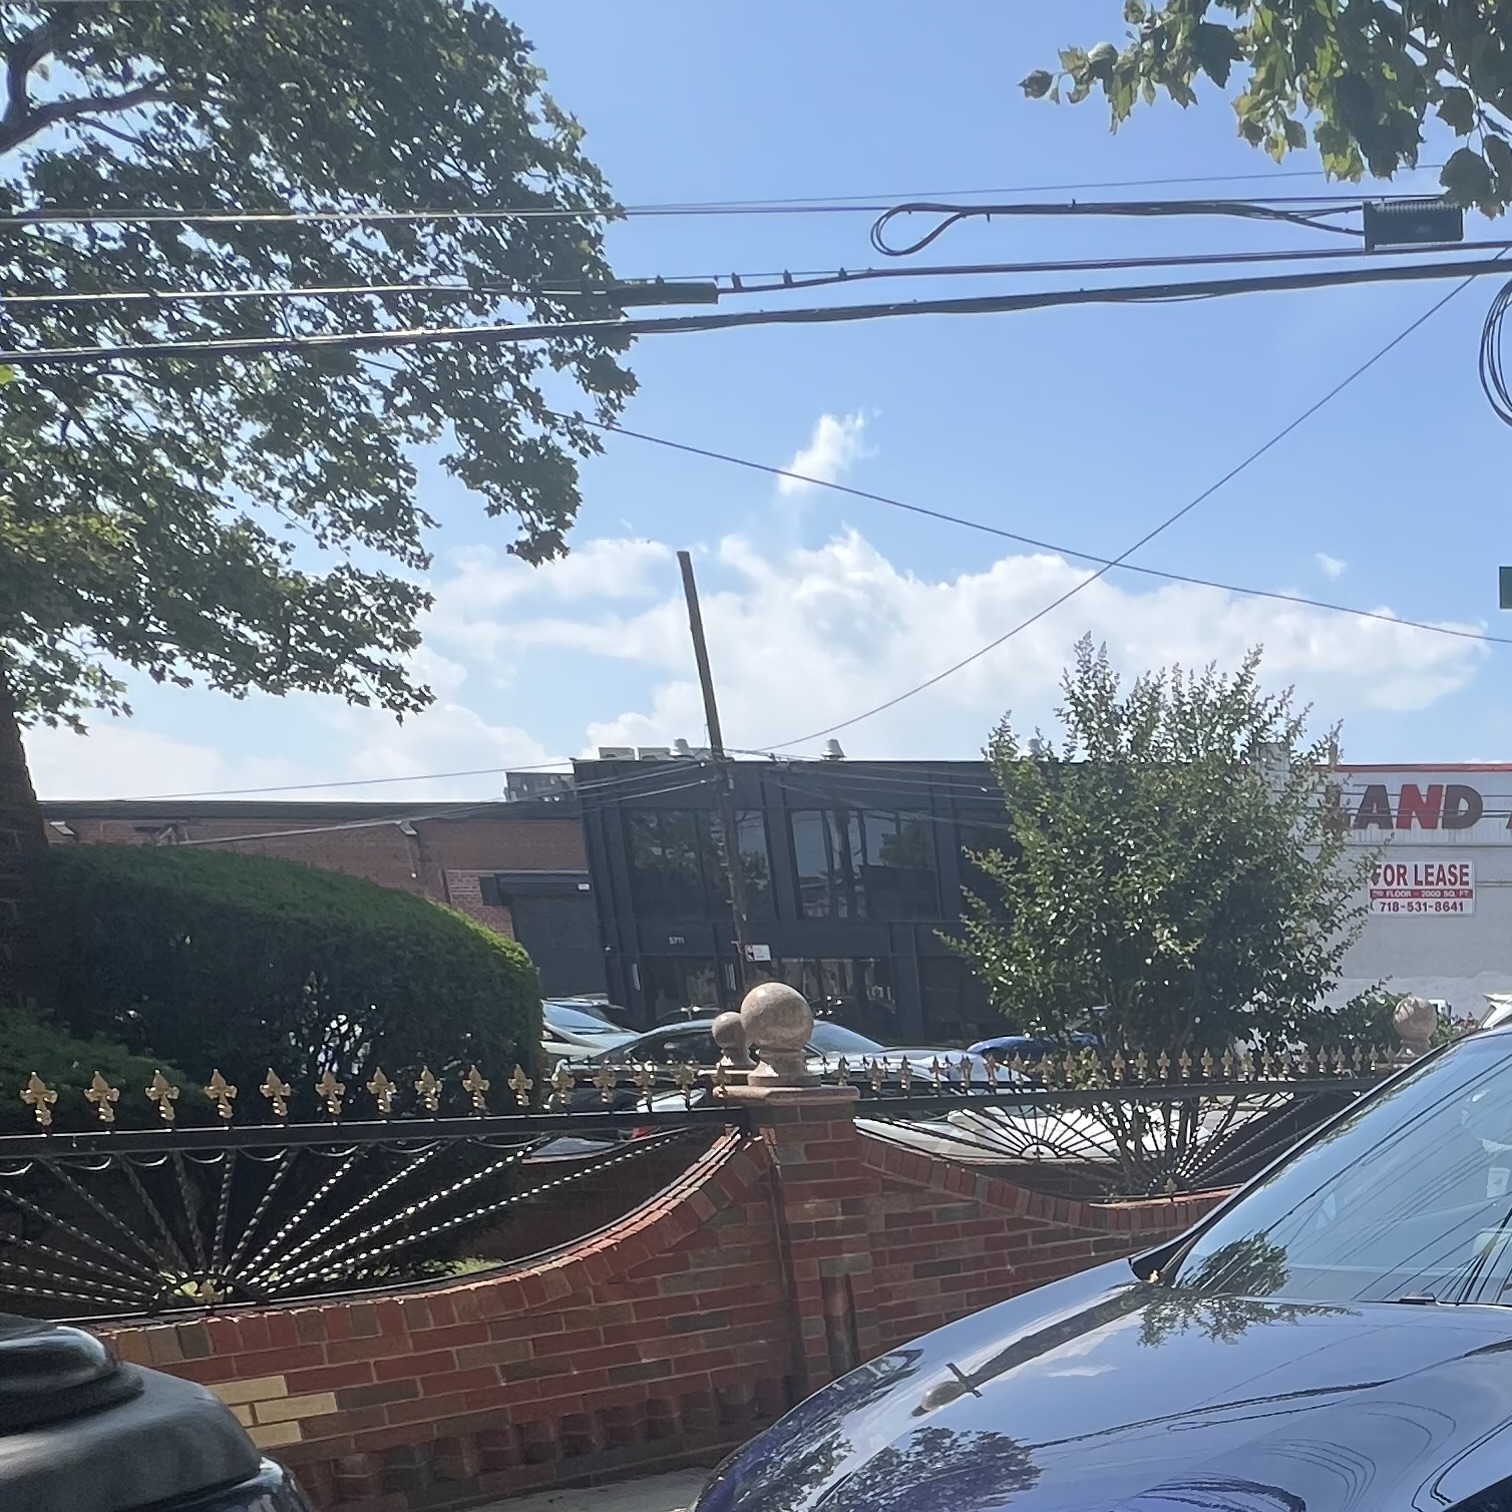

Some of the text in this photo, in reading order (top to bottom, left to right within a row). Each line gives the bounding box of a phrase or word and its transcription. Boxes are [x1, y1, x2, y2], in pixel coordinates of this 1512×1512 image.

[1373, 864, 1470, 887] OR LEASE
[1386, 890, 1412, 898] FLOOR
[1379, 901, 1464, 913] 718-531-8641
